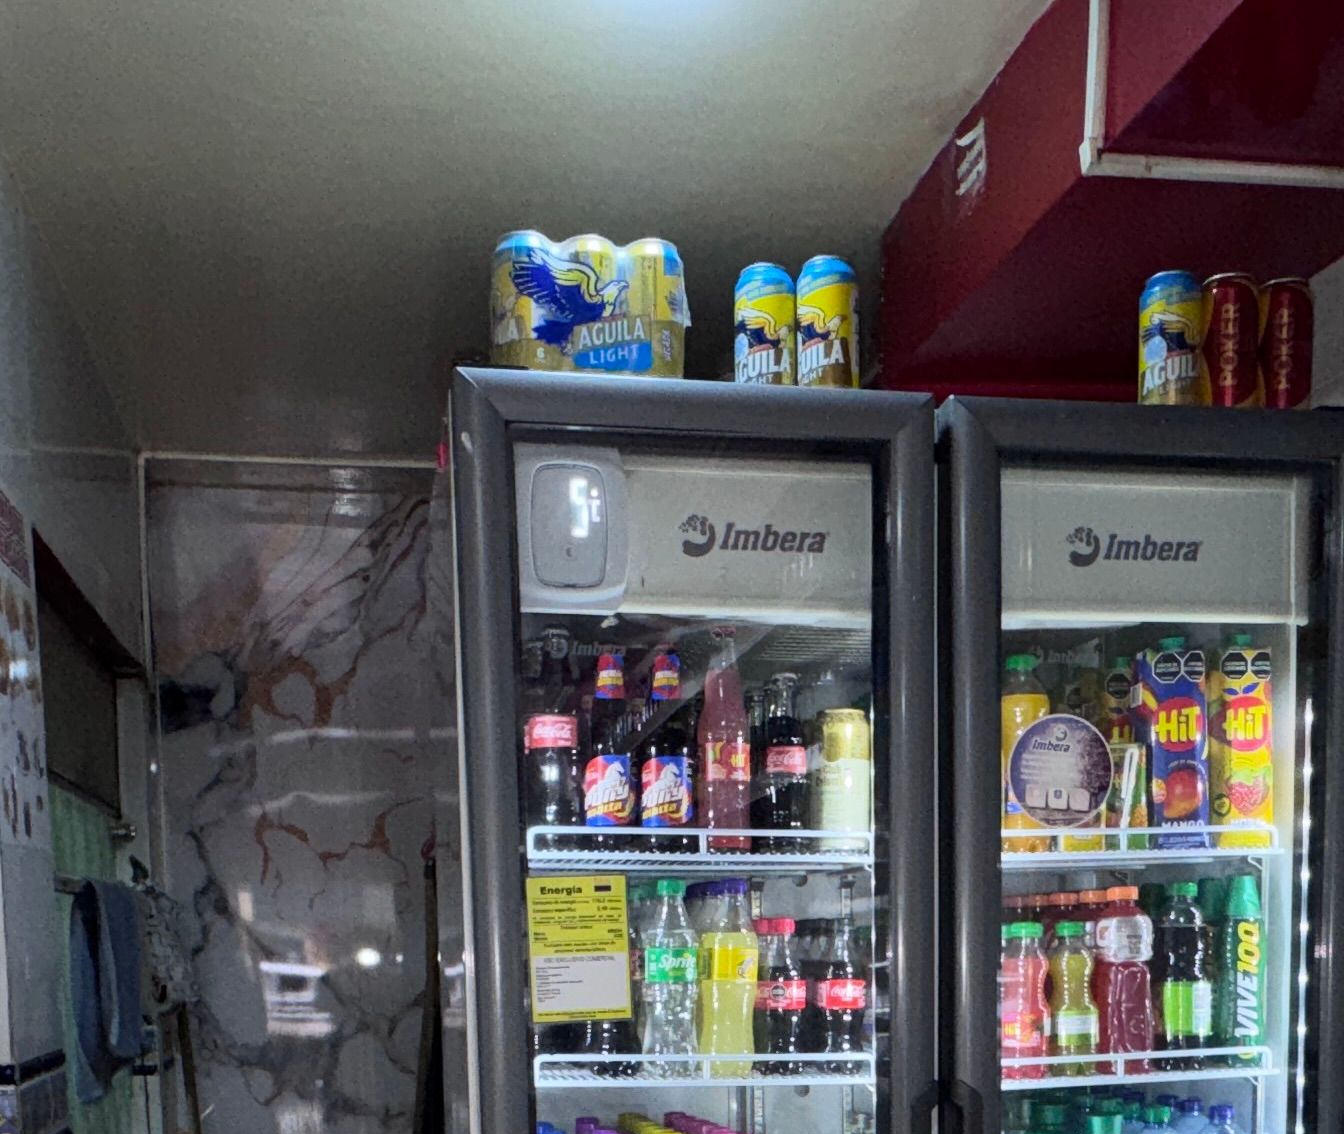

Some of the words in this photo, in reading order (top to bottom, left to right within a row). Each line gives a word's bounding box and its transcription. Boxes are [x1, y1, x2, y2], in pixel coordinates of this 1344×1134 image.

[578, 317, 646, 350] AGUILA
[1219, 303, 1240, 388] POKER
[589, 344, 639, 365] LIGHT
[736, 348, 791, 383] GUILA
[1142, 353, 1200, 396] AGUIL
[719, 521, 827, 554] Imbera
[1103, 533, 1200, 562] Imbera
